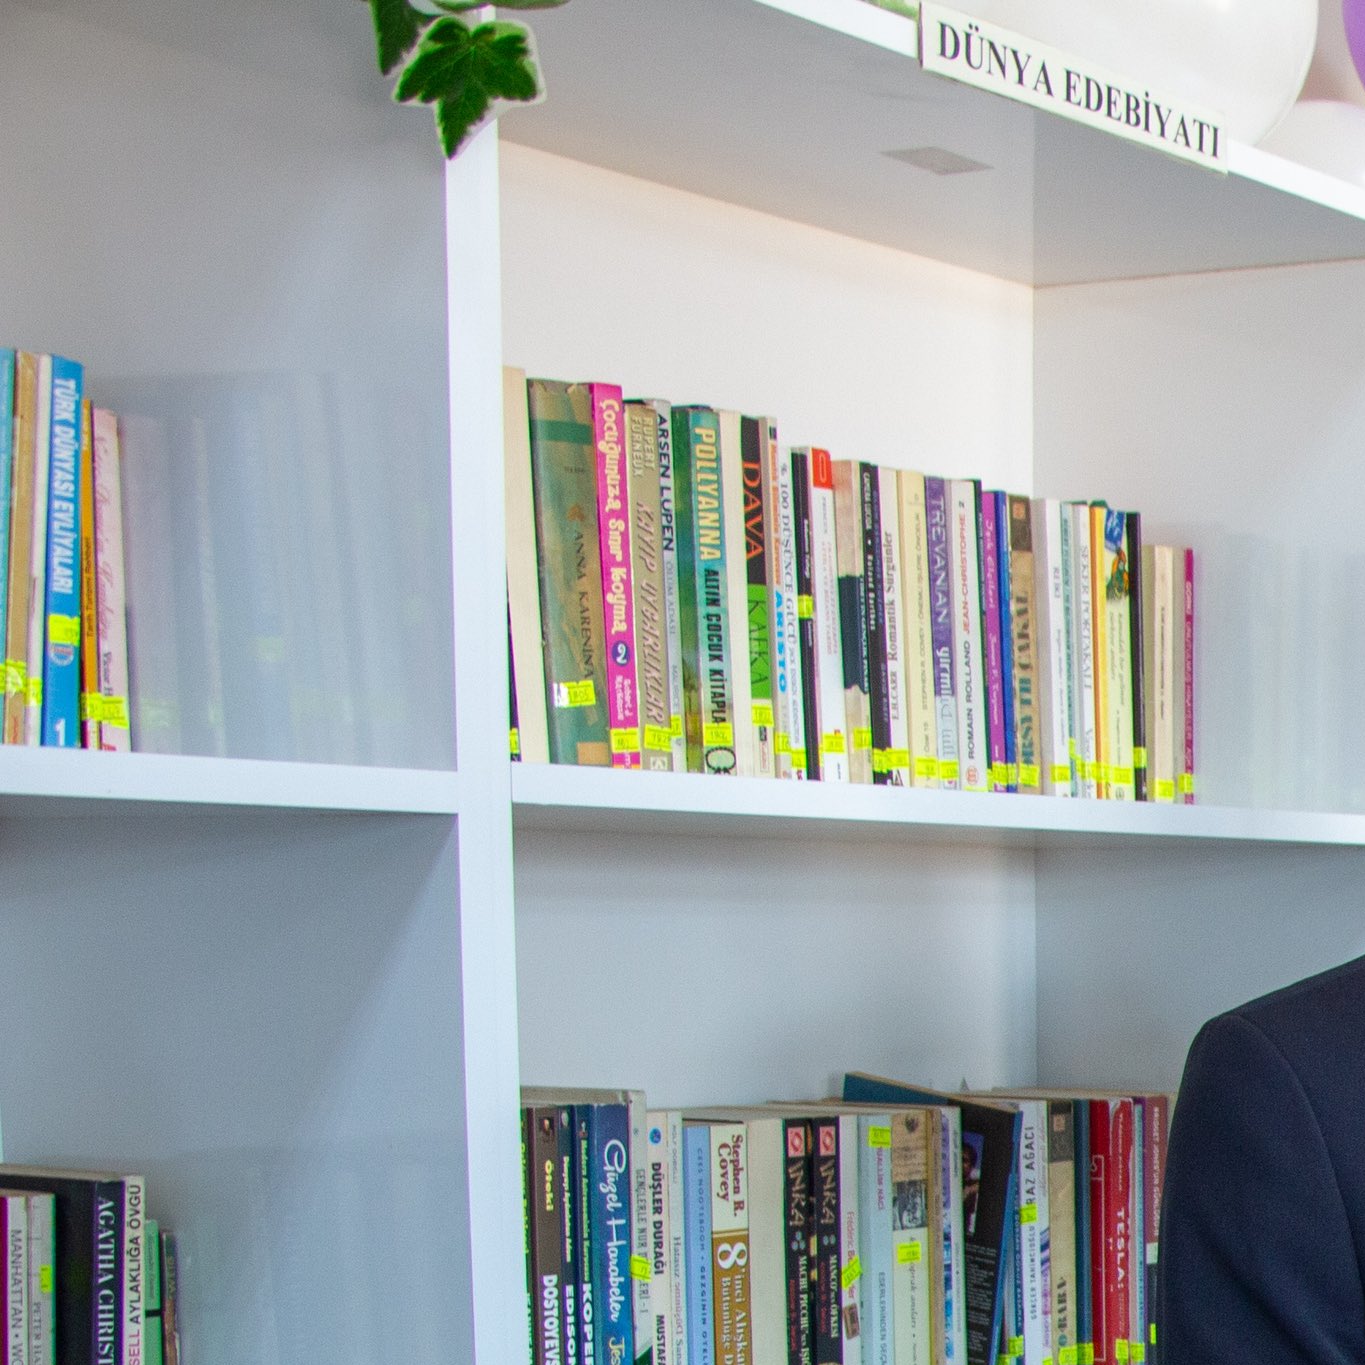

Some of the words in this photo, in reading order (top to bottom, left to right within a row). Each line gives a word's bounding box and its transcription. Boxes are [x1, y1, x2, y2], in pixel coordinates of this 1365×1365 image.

[937, 21, 1055, 98] DÜNYA
[1064, 68, 1223, 160] EDEBİYATI
[55, 379, 79, 422] TÜRK
[54, 425, 78, 498] DÜNYASI
[642, 418, 656, 469] RUPERT
[656, 413, 672, 479] ARSEN
[693, 427, 721, 561] POLLYANNA
[741, 462, 766, 561] DAVA
[781, 483, 790, 509] 100
[52, 501, 77, 594] EVLİYALARI
[573, 531, 589, 579] ANNA
[636, 502, 659, 572] KAYIP
[781, 514, 793, 593] DÜŞÜNCE
[930, 498, 951, 622] TREVANIAN
[606, 567, 628, 634] Koyma
[704, 568, 723, 608] ALTIN
[704, 613, 726, 662] ÇOCUK
[748, 600, 769, 685] KAFKA
[785, 597, 795, 644] GÜCÜ
[886, 600, 898, 662] Romantik
[1081, 600, 1092, 690] PORTAKALI
[963, 640, 973, 703] ROLLAND
[965, 708, 976, 760] ROMAIN
[600, 1140, 627, 1211] Güzel
[717, 1142, 732, 1202] Covey
[729, 1135, 746, 1194] Stephen
[1024, 1127, 1035, 1171] AĞACI
[128, 1185, 142, 1229] ÖVGÜ
[651, 1162, 664, 1215] DÜŞLER
[733, 1200, 744, 1217] R.
[98, 1196, 115, 1284] AGATHA
[605, 1217, 626, 1322] Harabeler
[653, 1220, 666, 1275] DURAĞI
[10, 1229, 23, 1329] MANHATTAN
[127, 1236, 142, 1325] AYLAKLIĞA
